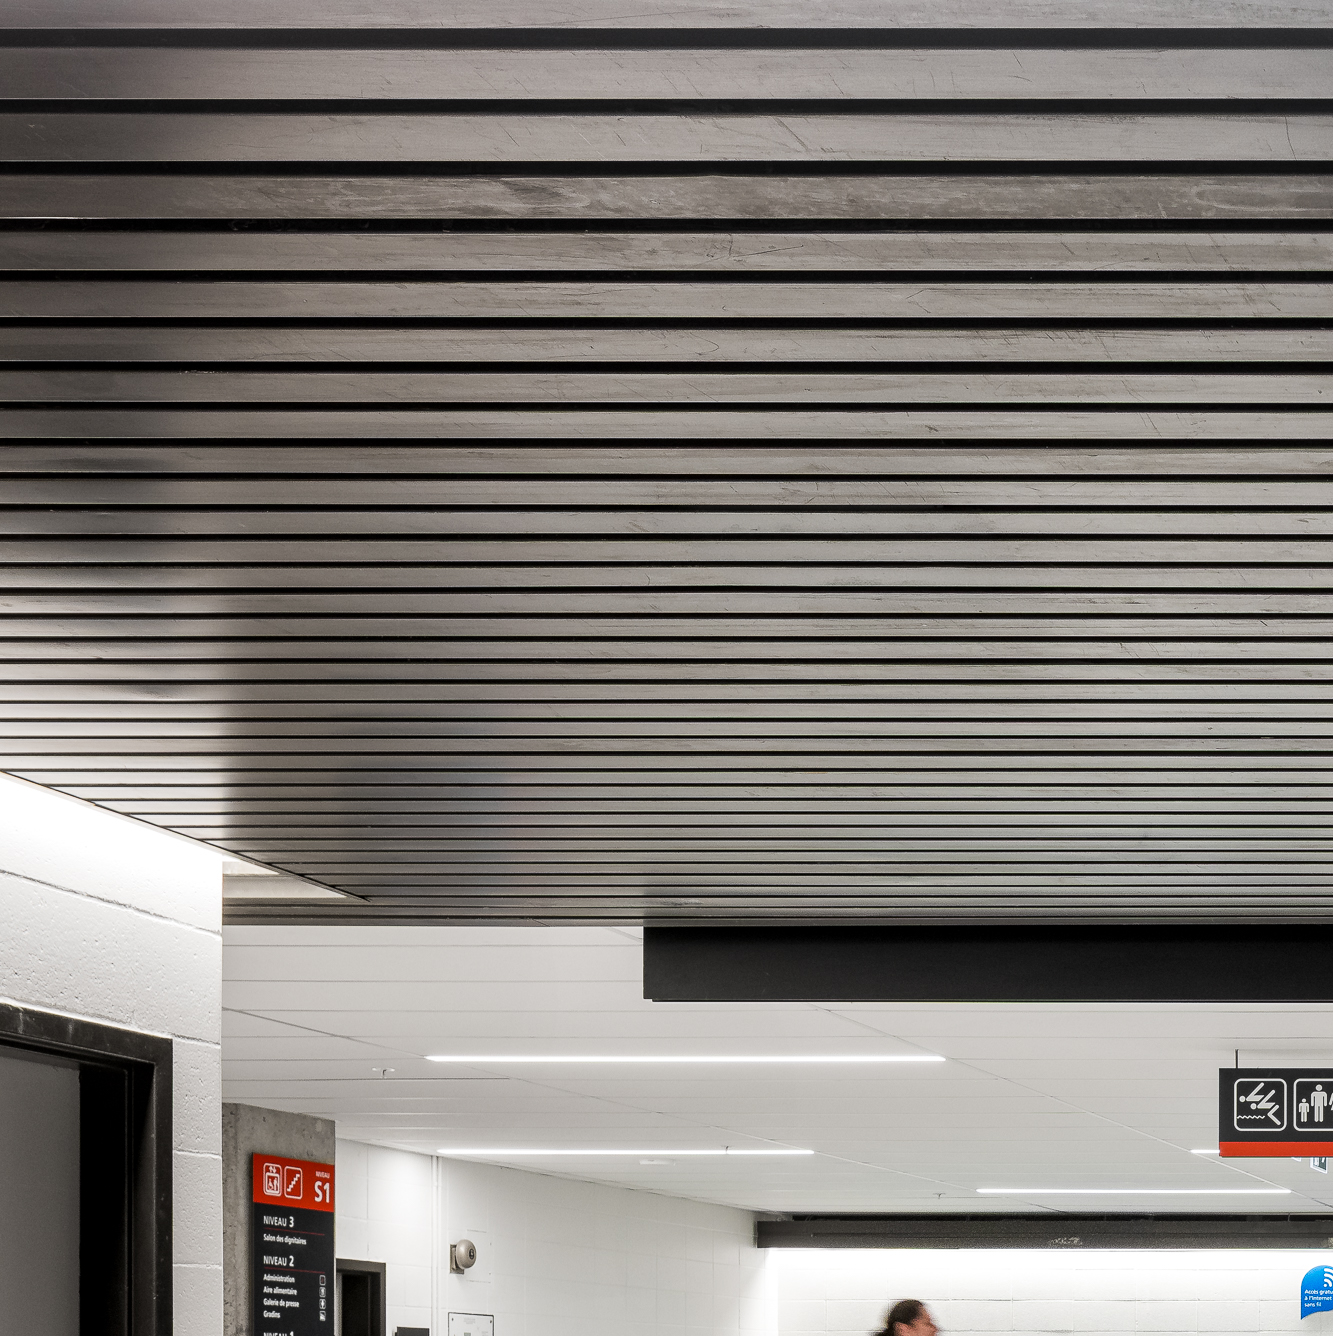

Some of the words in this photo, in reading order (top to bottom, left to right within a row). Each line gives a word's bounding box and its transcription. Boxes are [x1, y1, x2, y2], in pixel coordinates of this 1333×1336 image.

[315, 1171, 331, 1179] NIVEAU
[314, 1181, 331, 1204] S1
[263, 1215, 288, 1227] NIVEAU
[288, 1216, 295, 1228] 3
[263, 1233, 276, 1242] Salon
[276, 1234, 284, 1243] des
[284, 1235, 307, 1245] dignitaires
[263, 1255, 288, 1266] NIVEAU
[288, 1255, 295, 1267] 2
[263, 1273, 296, 1283] Administration
[263, 1286, 272, 1294] Aire
[273, 1286, 298, 1296] alimentaire
[263, 1297, 280, 1307] Galerie
[280, 1298, 285, 1307] de
[285, 1300, 300, 1309] presse
[263, 1310, 281, 1319] Gradins
